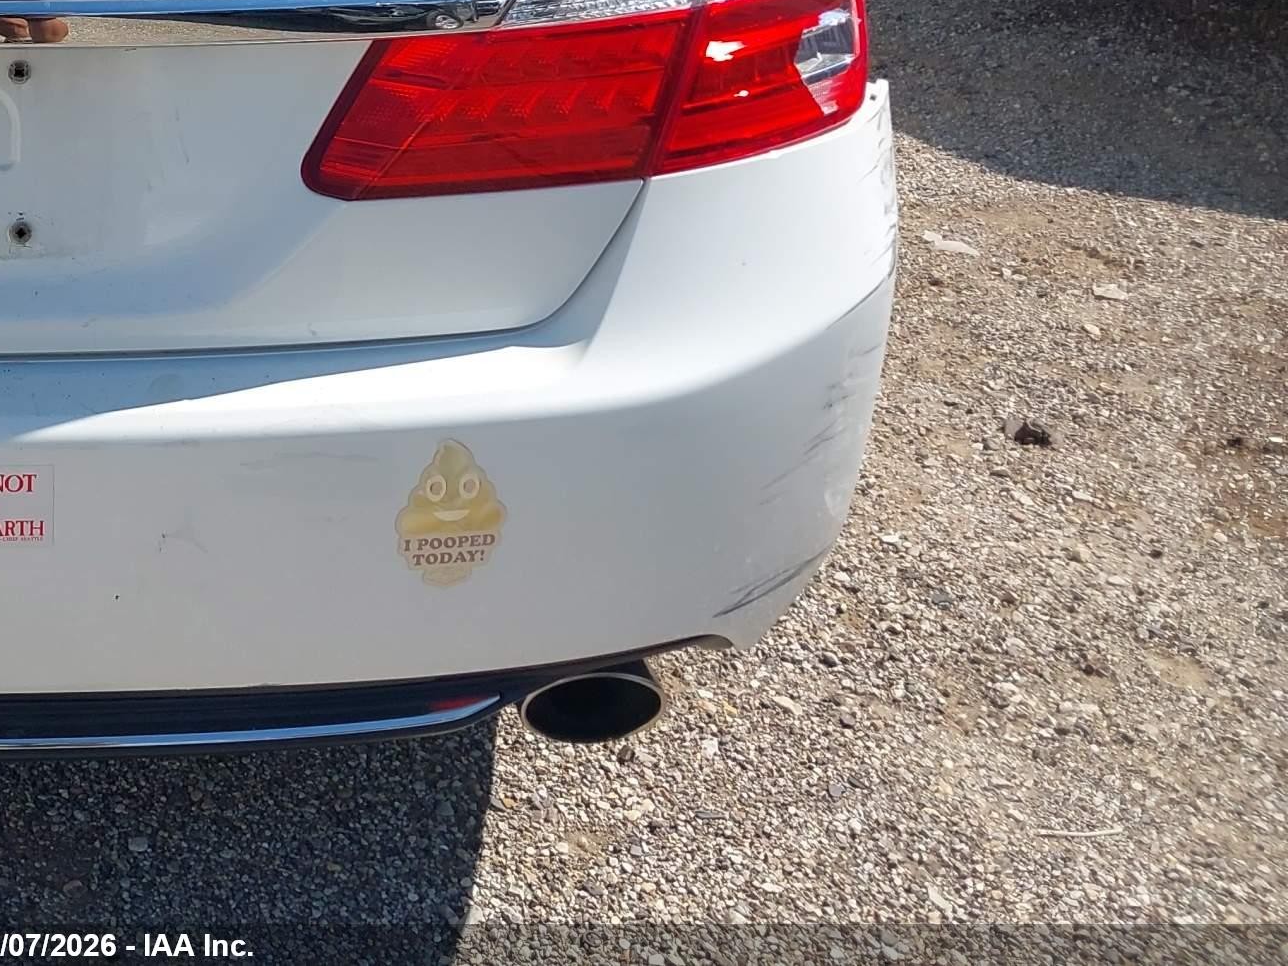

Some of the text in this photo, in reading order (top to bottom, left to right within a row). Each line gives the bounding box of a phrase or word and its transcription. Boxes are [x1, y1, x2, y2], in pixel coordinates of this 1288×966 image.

[404, 534, 496, 552] I POOPED
[412, 550, 485, 566] TODAY!
